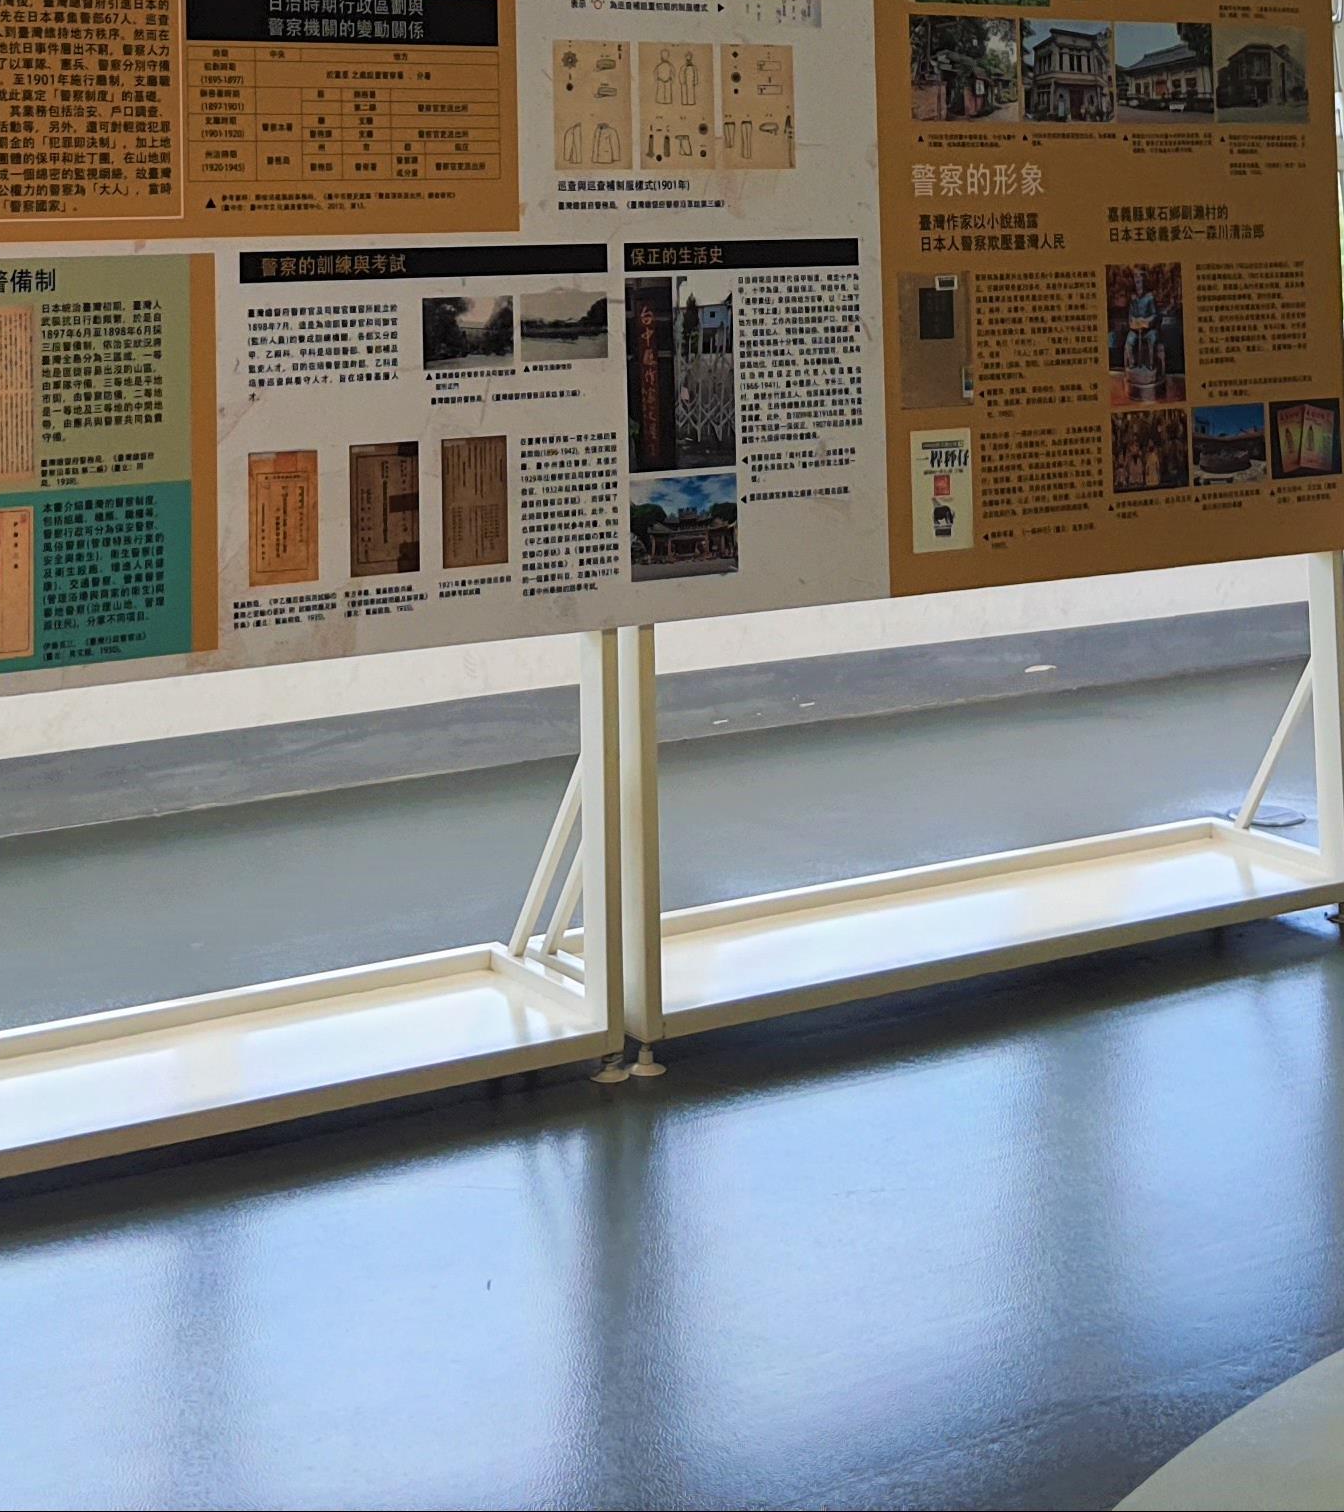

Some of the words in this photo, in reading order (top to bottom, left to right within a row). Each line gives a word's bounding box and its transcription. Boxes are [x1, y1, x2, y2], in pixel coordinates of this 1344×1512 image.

[268, 17, 424, 40] 警察機關的變動關係
[911, 163, 1045, 198] 警察的形象
[261, 254, 406, 278] 警察的訓練與考試
[630, 247, 723, 265] 保正的生活史
